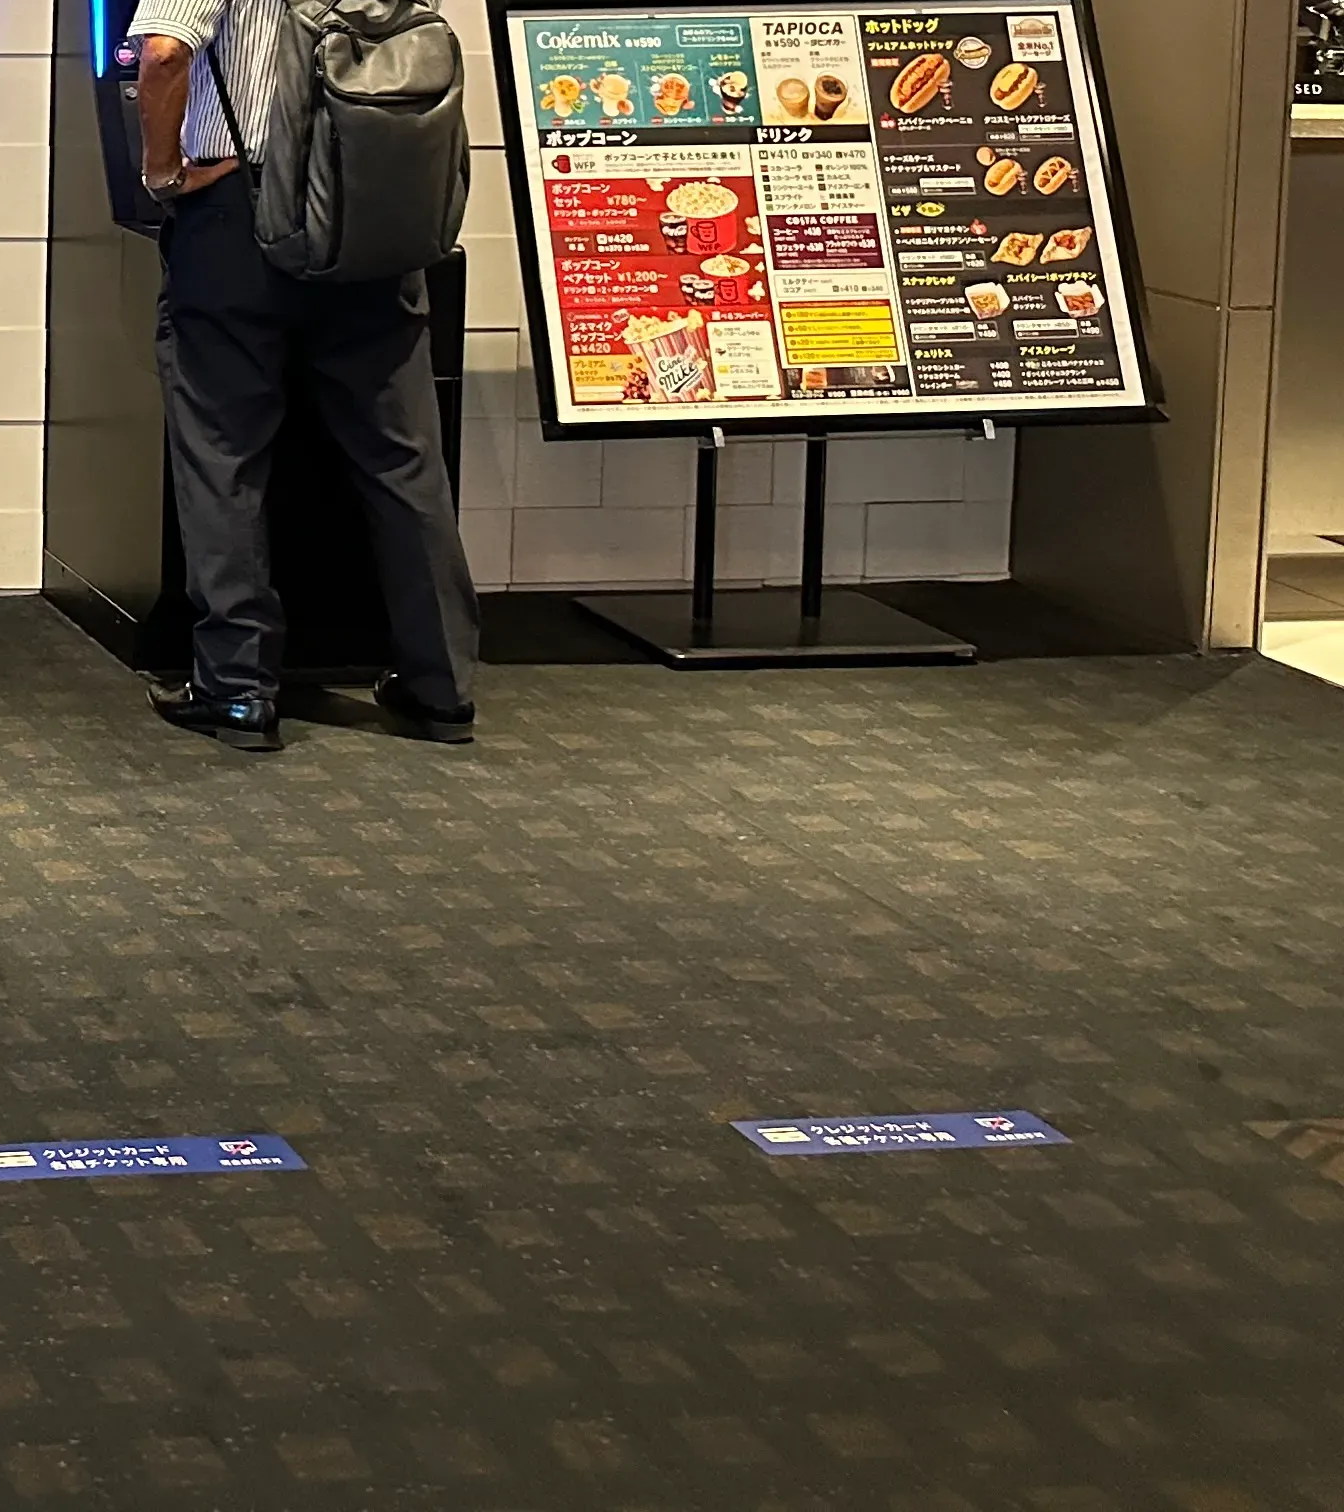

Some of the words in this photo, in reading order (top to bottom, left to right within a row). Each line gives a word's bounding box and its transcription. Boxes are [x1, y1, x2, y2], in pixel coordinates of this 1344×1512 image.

[762, 22, 843, 35] TAPIOCA
[865, 17, 939, 34] ホットドッグ
[536, 30, 621, 50] Cokemix
[868, 40, 953, 51] プレミアムホットドッグ
[546, 130, 638, 146] ポップコーン
[757, 128, 812, 143] ドリンク
[575, 161, 596, 170] WFP
[552, 183, 610, 194] ポップコーン
[554, 197, 581, 208] セット
[891, 205, 912, 217] ピザ
[785, 217, 817, 225] COSTA
[820, 216, 858, 224] COFFEE
[561, 260, 620, 270] ポップコーン
[563, 274, 612, 284] ペアセット
[570, 322, 612, 332] シネマイク
[571, 332, 624, 343] ポップコーン
[915, 349, 953, 359] チュリトス
[1020, 345, 1075, 355] アイスクレープ
[43, 1145, 170, 1158] クレジットカード
[50, 1156, 187, 1170] 各種チケット専用
